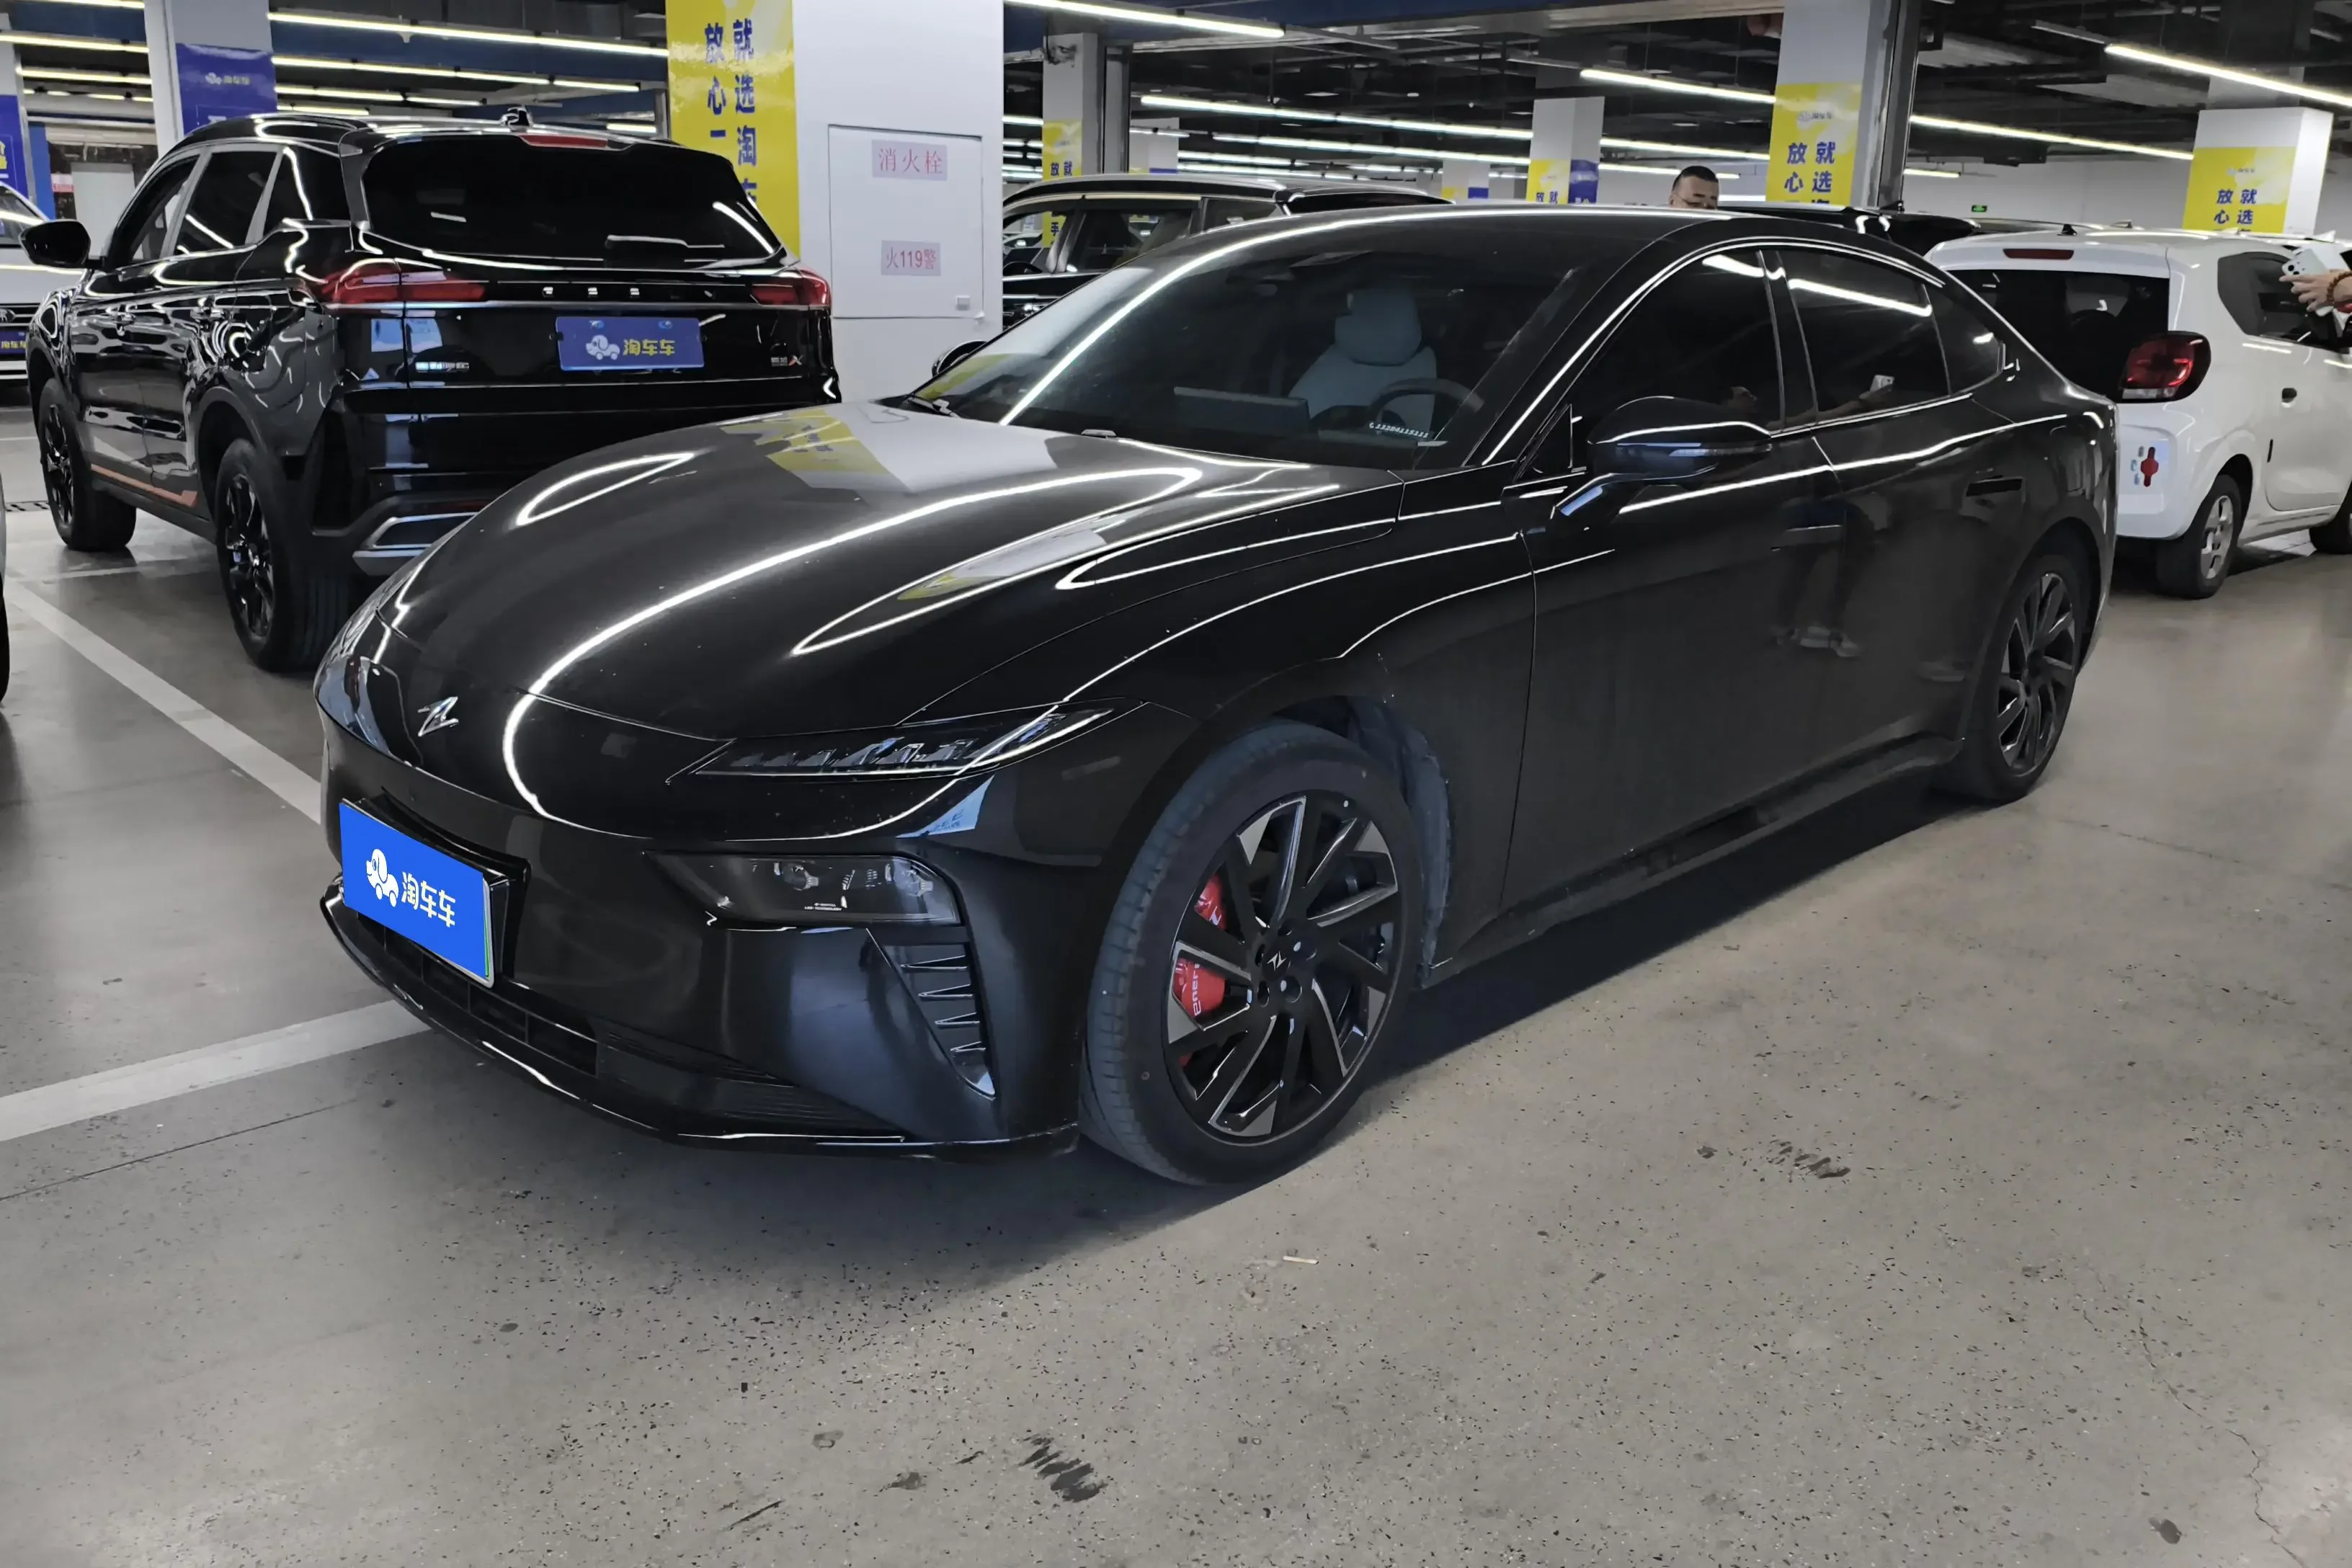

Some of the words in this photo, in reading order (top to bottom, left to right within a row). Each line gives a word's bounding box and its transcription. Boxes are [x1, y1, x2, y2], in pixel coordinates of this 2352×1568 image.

[878, 148, 943, 174] 消火栓
[1812, 141, 1835, 203] 就选
[2214, 190, 2233, 231] 放心
[2237, 189, 2257, 231] 就选
[886, 247, 936, 270] 火119警
[623, 339, 675, 356] 淘车车
